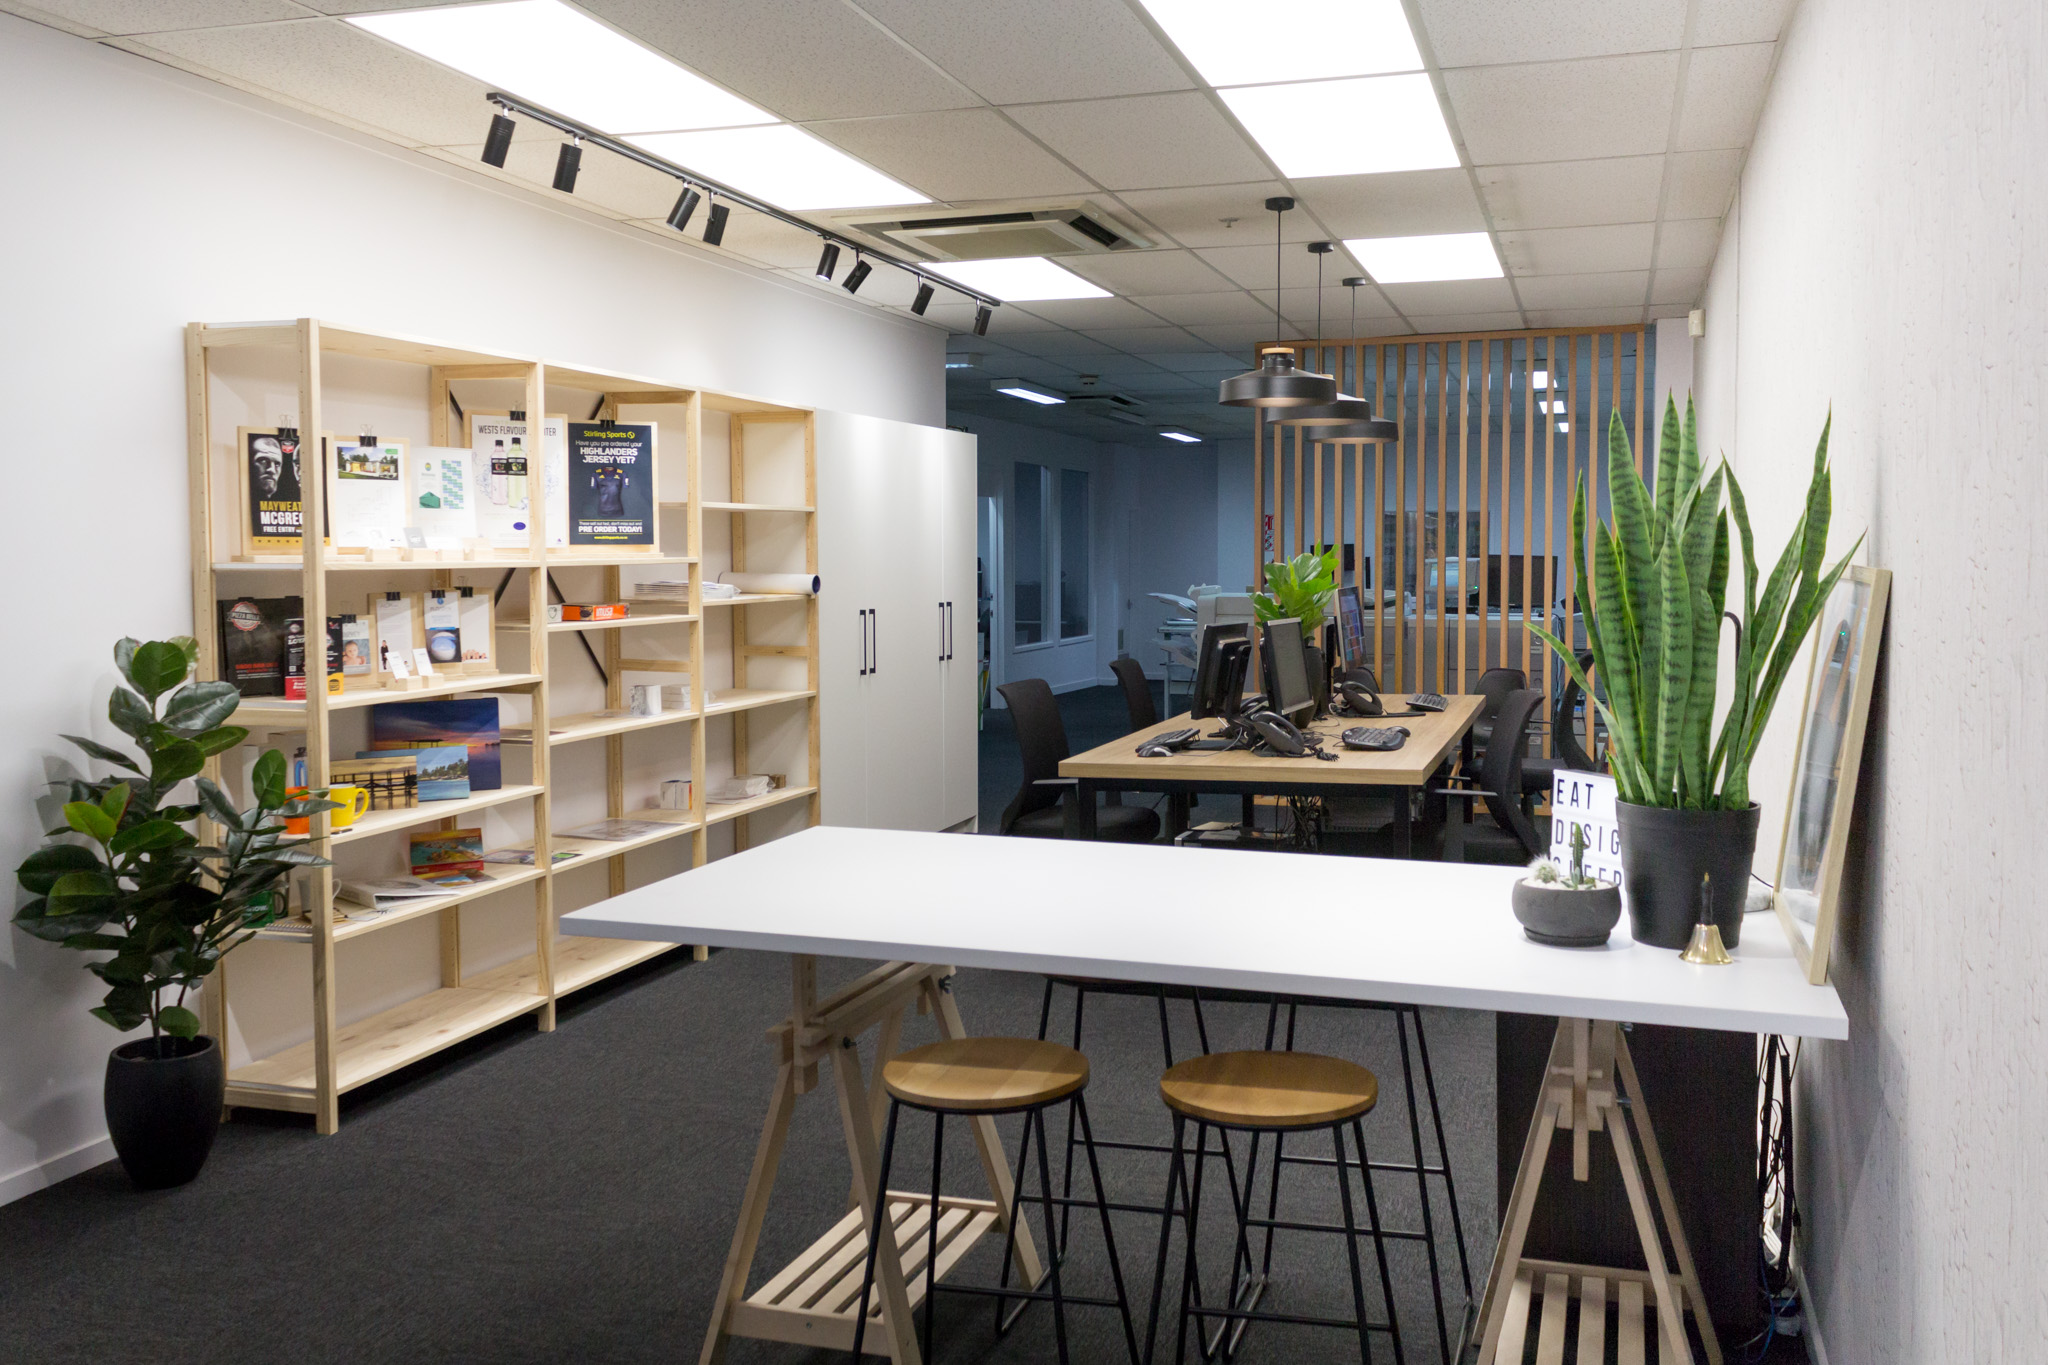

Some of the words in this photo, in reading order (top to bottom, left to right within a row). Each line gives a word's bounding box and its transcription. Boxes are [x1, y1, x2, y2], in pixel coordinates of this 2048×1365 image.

[478, 425, 498, 434] WESTS
[500, 426, 527, 435] FLAVOUR
[580, 447, 638, 456] HIGHLANDERS
[583, 455, 615, 463] JERSEY
[615, 456, 636, 464] YET?
[260, 501, 302, 511] MAYWEAT
[261, 512, 302, 525] MCGRE
[1556, 778, 1594, 810] EAT
[1555, 818, 1620, 855] DESIG
